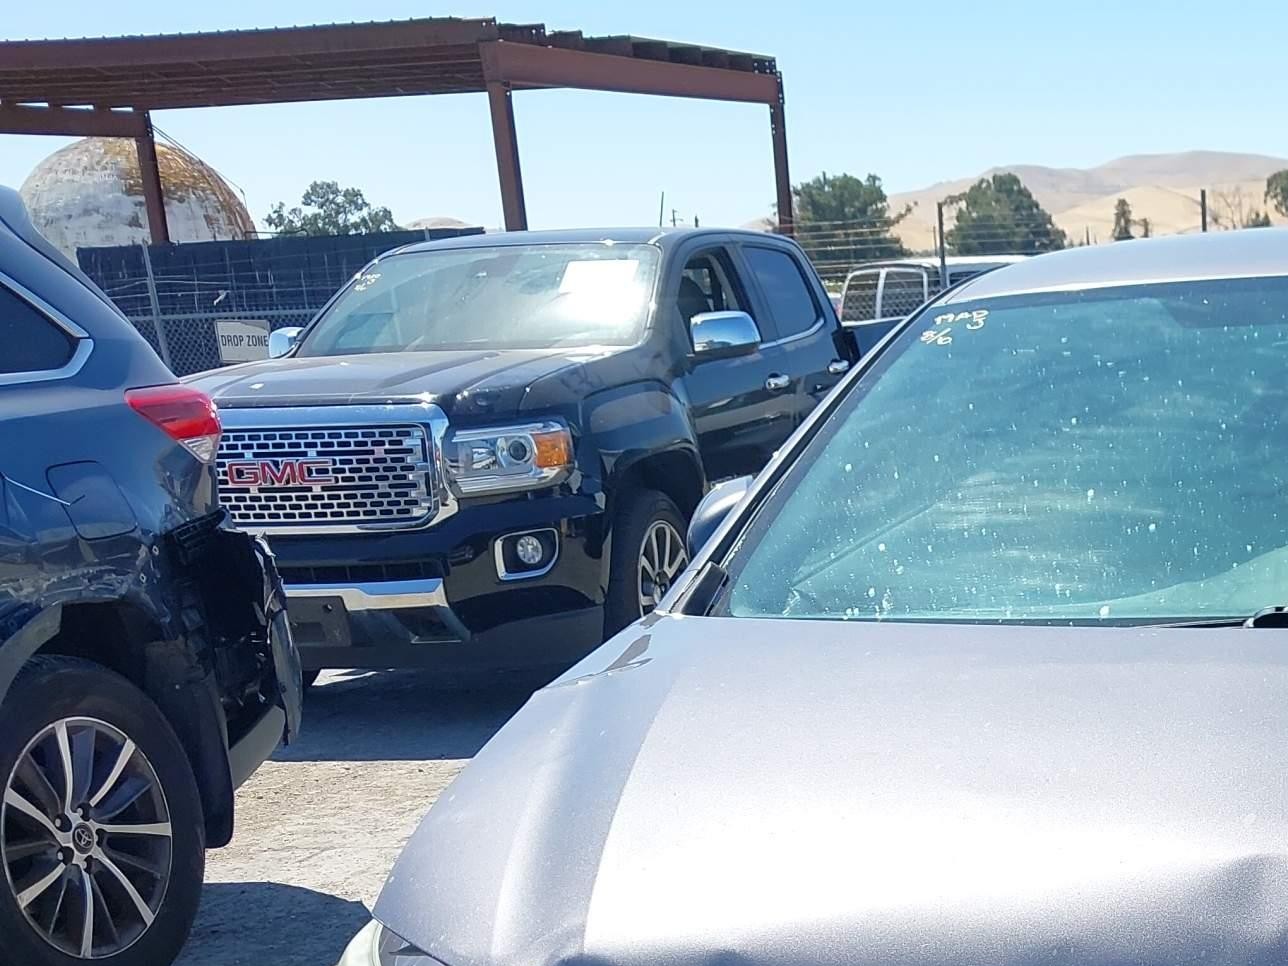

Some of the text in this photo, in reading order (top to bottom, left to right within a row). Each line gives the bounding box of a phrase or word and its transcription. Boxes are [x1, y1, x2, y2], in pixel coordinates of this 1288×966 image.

[221, 334, 269, 347] DROP ZONE
[226, 459, 335, 487] GMC
